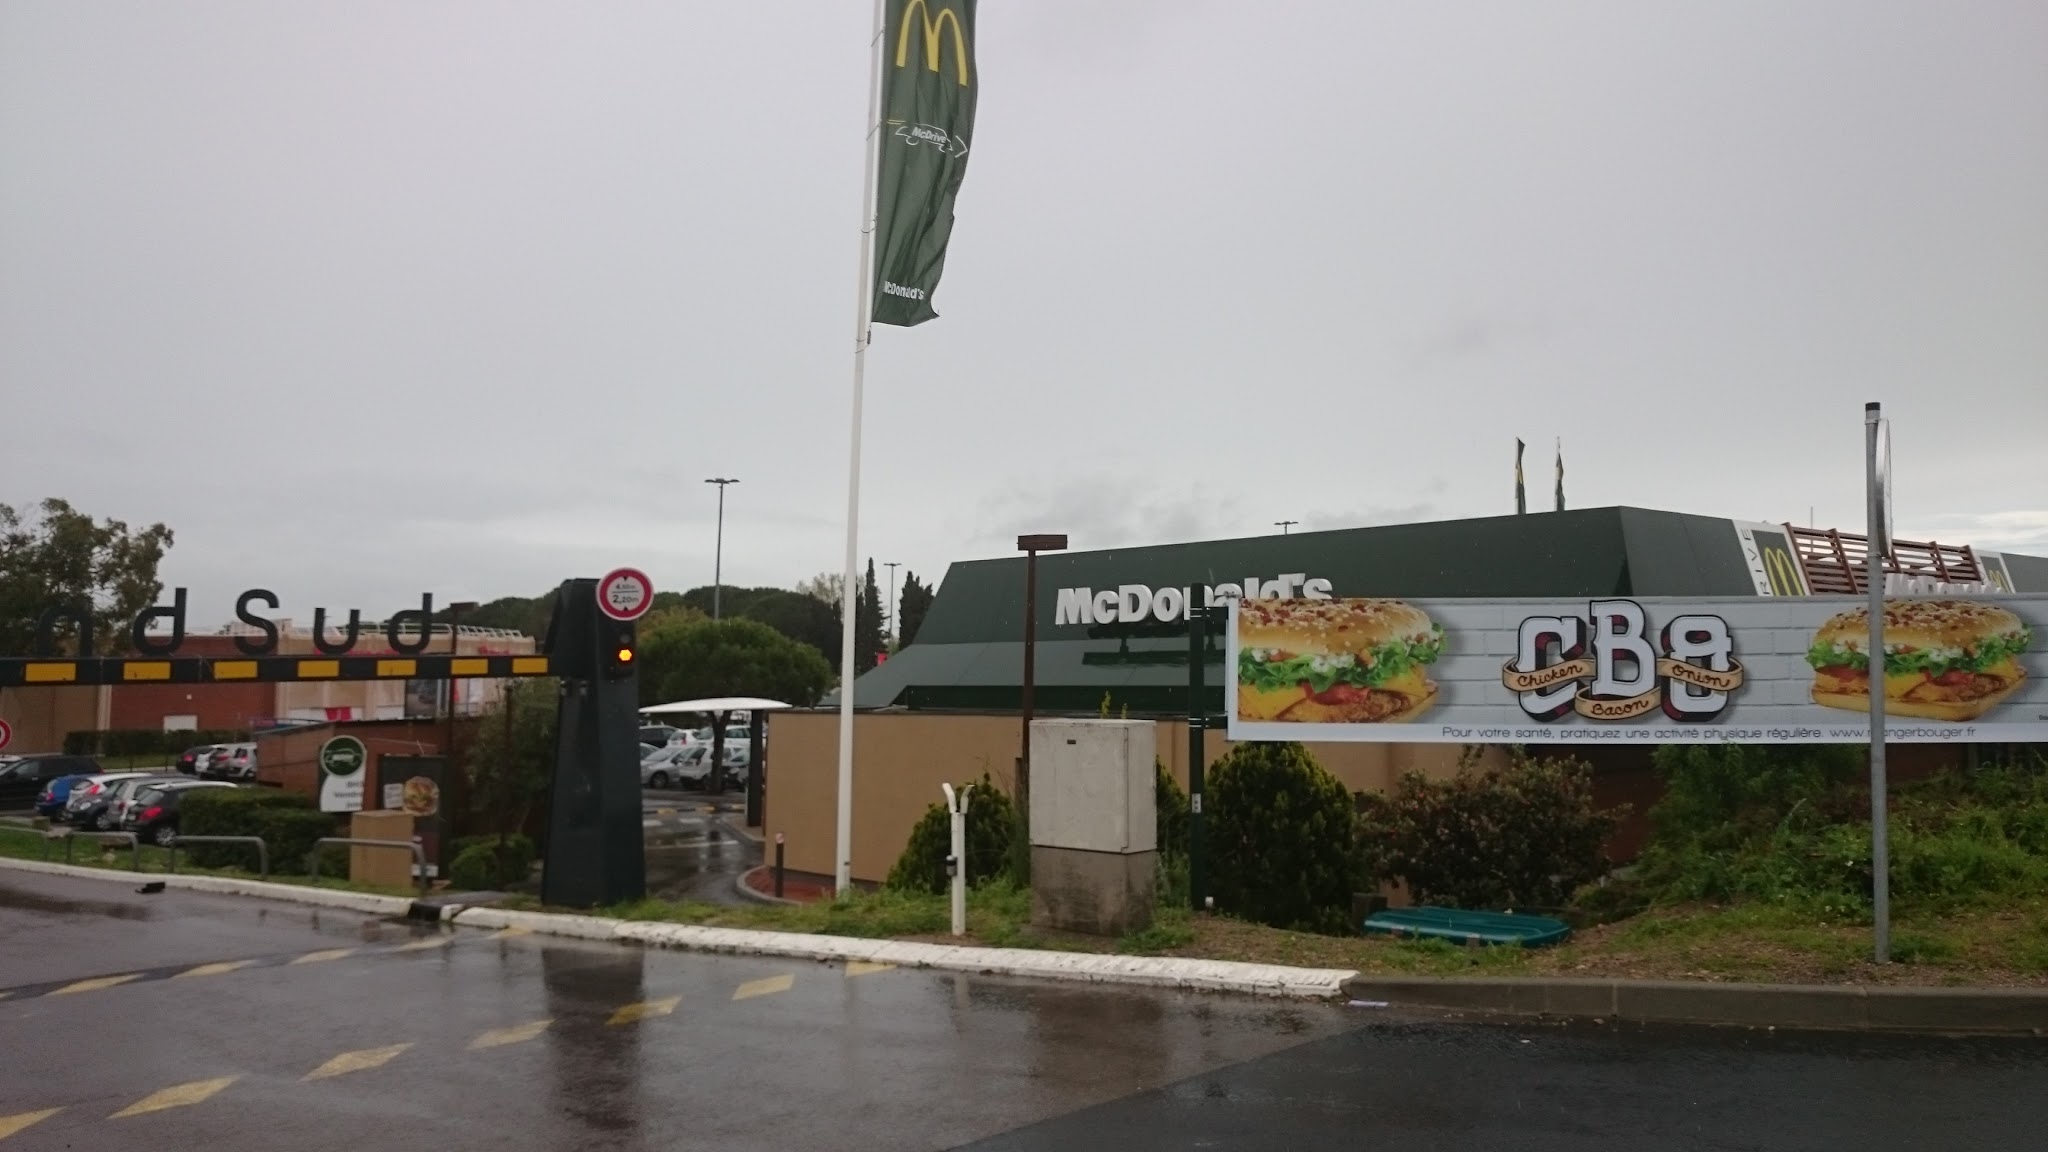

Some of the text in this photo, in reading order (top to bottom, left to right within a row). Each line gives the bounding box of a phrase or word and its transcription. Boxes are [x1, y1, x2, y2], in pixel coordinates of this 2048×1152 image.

[912, 126, 947, 143] McDrive
[234, 589, 433, 656] Sud
[1516, 663, 1584, 688] Chicken
[1671, 663, 1731, 688] Onion
[1590, 698, 1649, 717] Bacon
[1442, 726, 1472, 738] Pour
[1478, 727, 1511, 738] votre
[1515, 728, 1555, 739] santé,
[1560, 728, 1621, 740] pratiquez
[1625, 729, 1650, 739] une
[1654, 728, 1700, 739] activité
[1704, 728, 1762, 740] physique
